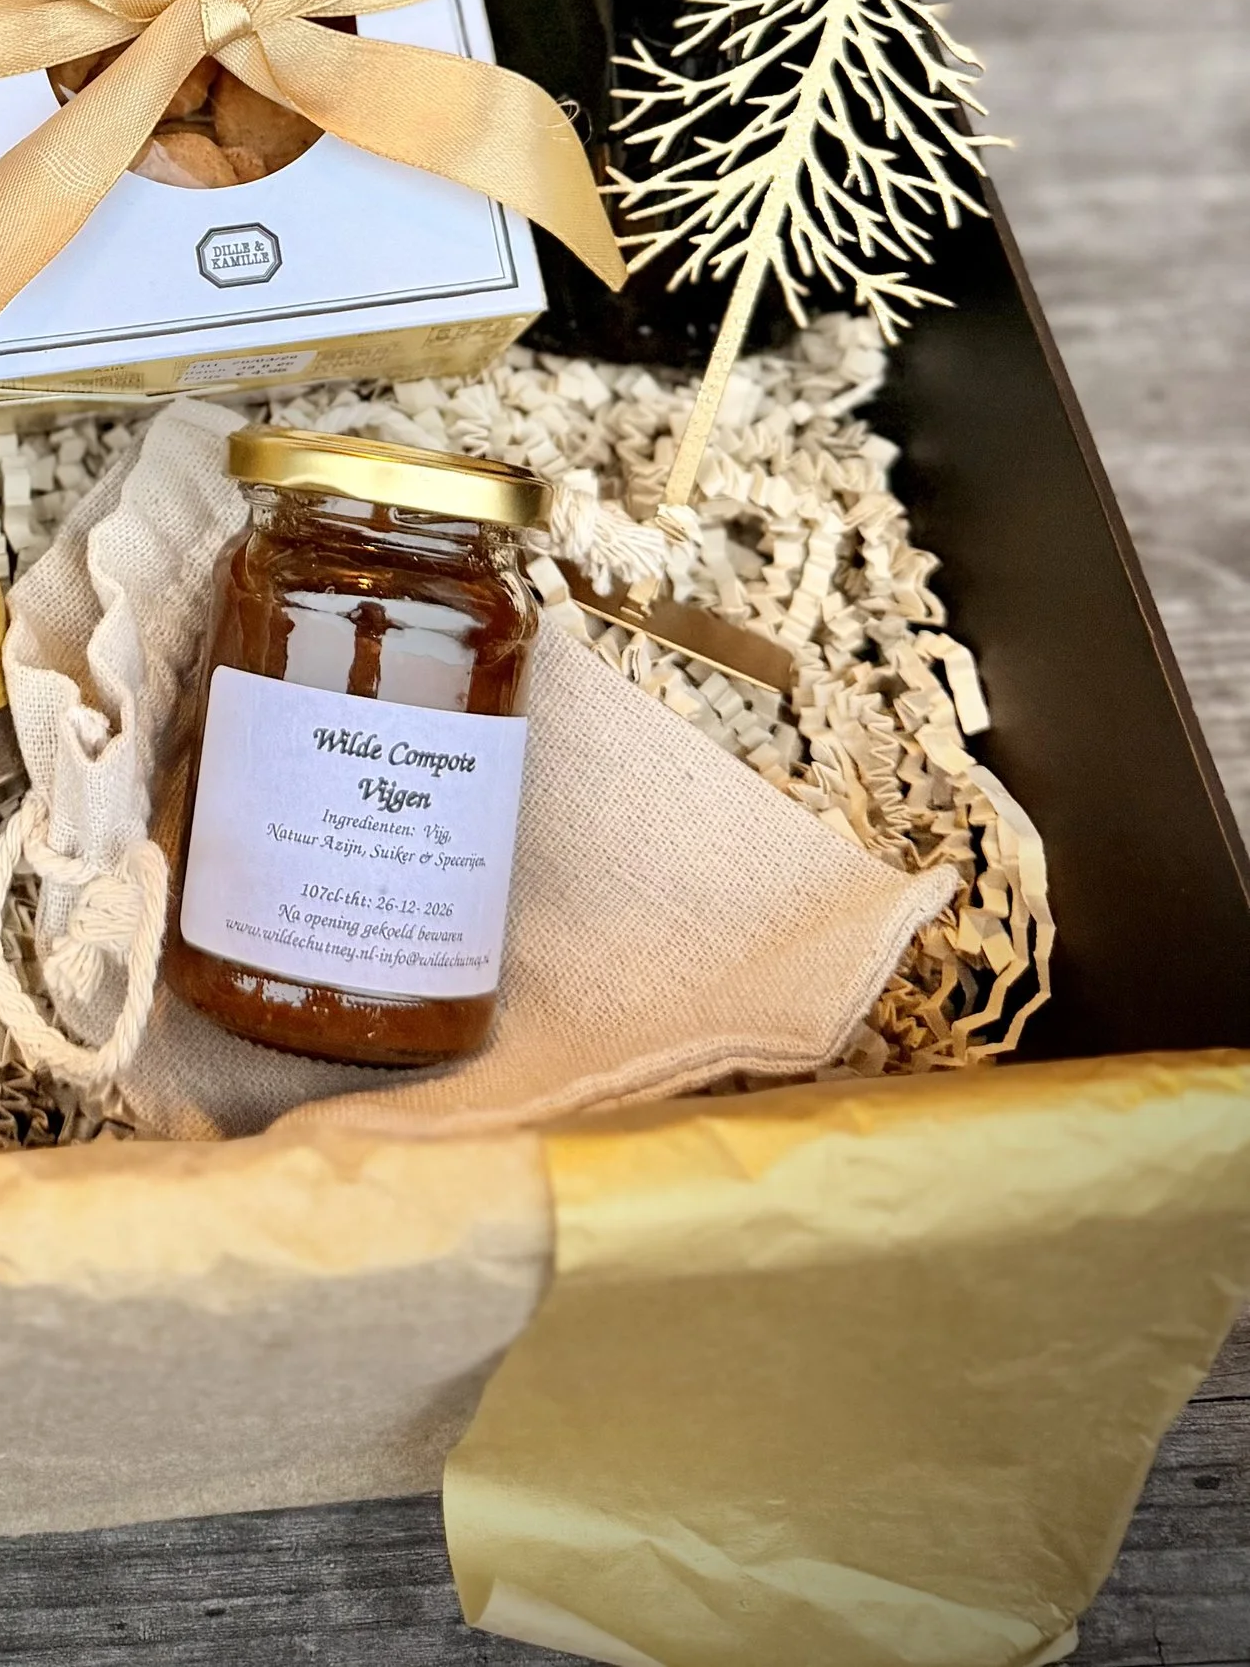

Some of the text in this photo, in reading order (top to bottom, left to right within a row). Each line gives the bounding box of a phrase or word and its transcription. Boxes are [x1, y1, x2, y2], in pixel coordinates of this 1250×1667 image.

[211, 252, 270, 269] KAMILLE
[212, 241, 264, 257] DILLE &
[313, 727, 476, 778] Wilde Compote
[358, 777, 431, 813] Vijgen
[322, 809, 416, 837] Ingredienten:
[266, 822, 318, 845] Natuur
[320, 835, 366, 858] Azijn,
[369, 844, 416, 865] Suiker
[419, 851, 434, 864] &
[300, 883, 372, 909] 107cl-tht:
[424, 902, 454, 917] 2026
[278, 903, 463, 942] Na opening gekoeld bewaren
